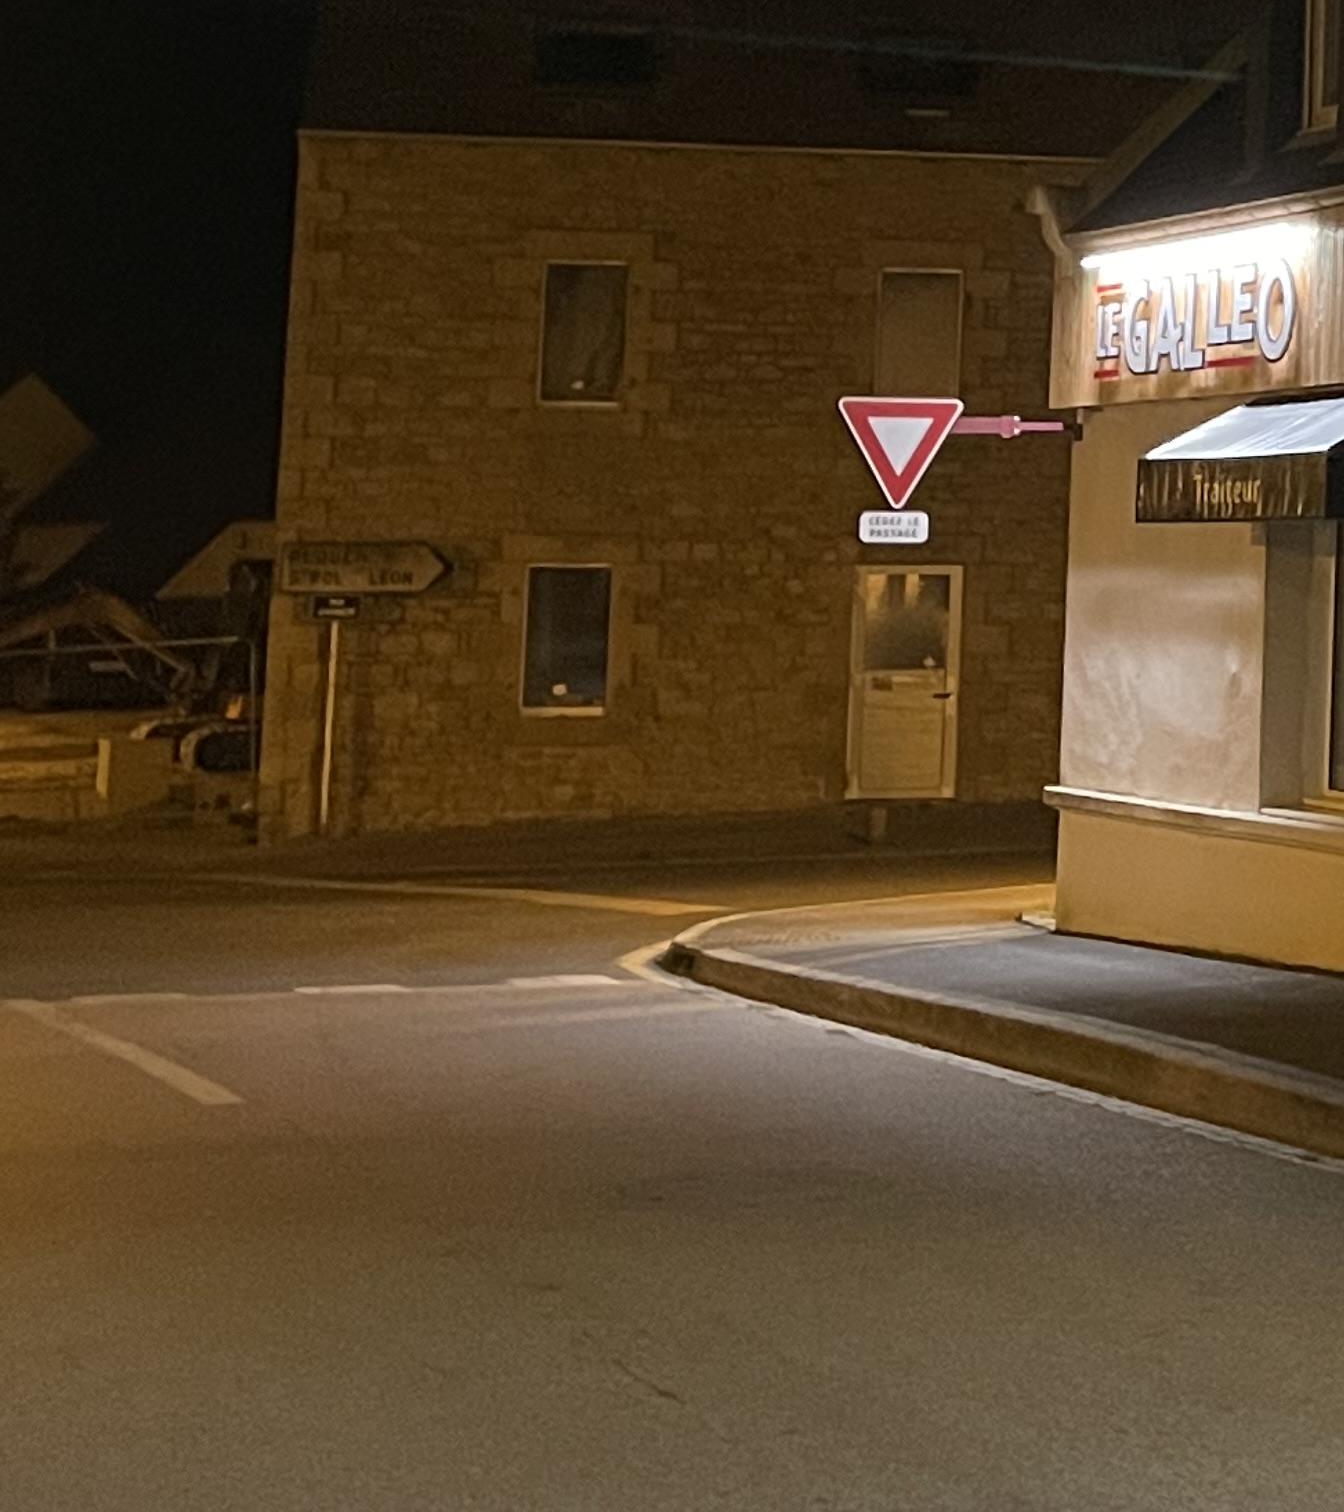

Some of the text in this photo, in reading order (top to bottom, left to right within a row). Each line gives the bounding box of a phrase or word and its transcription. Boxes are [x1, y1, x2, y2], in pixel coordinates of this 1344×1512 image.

[1096, 257, 1297, 374] LE GALLEO
[1192, 473, 1261, 504] Traiteur
